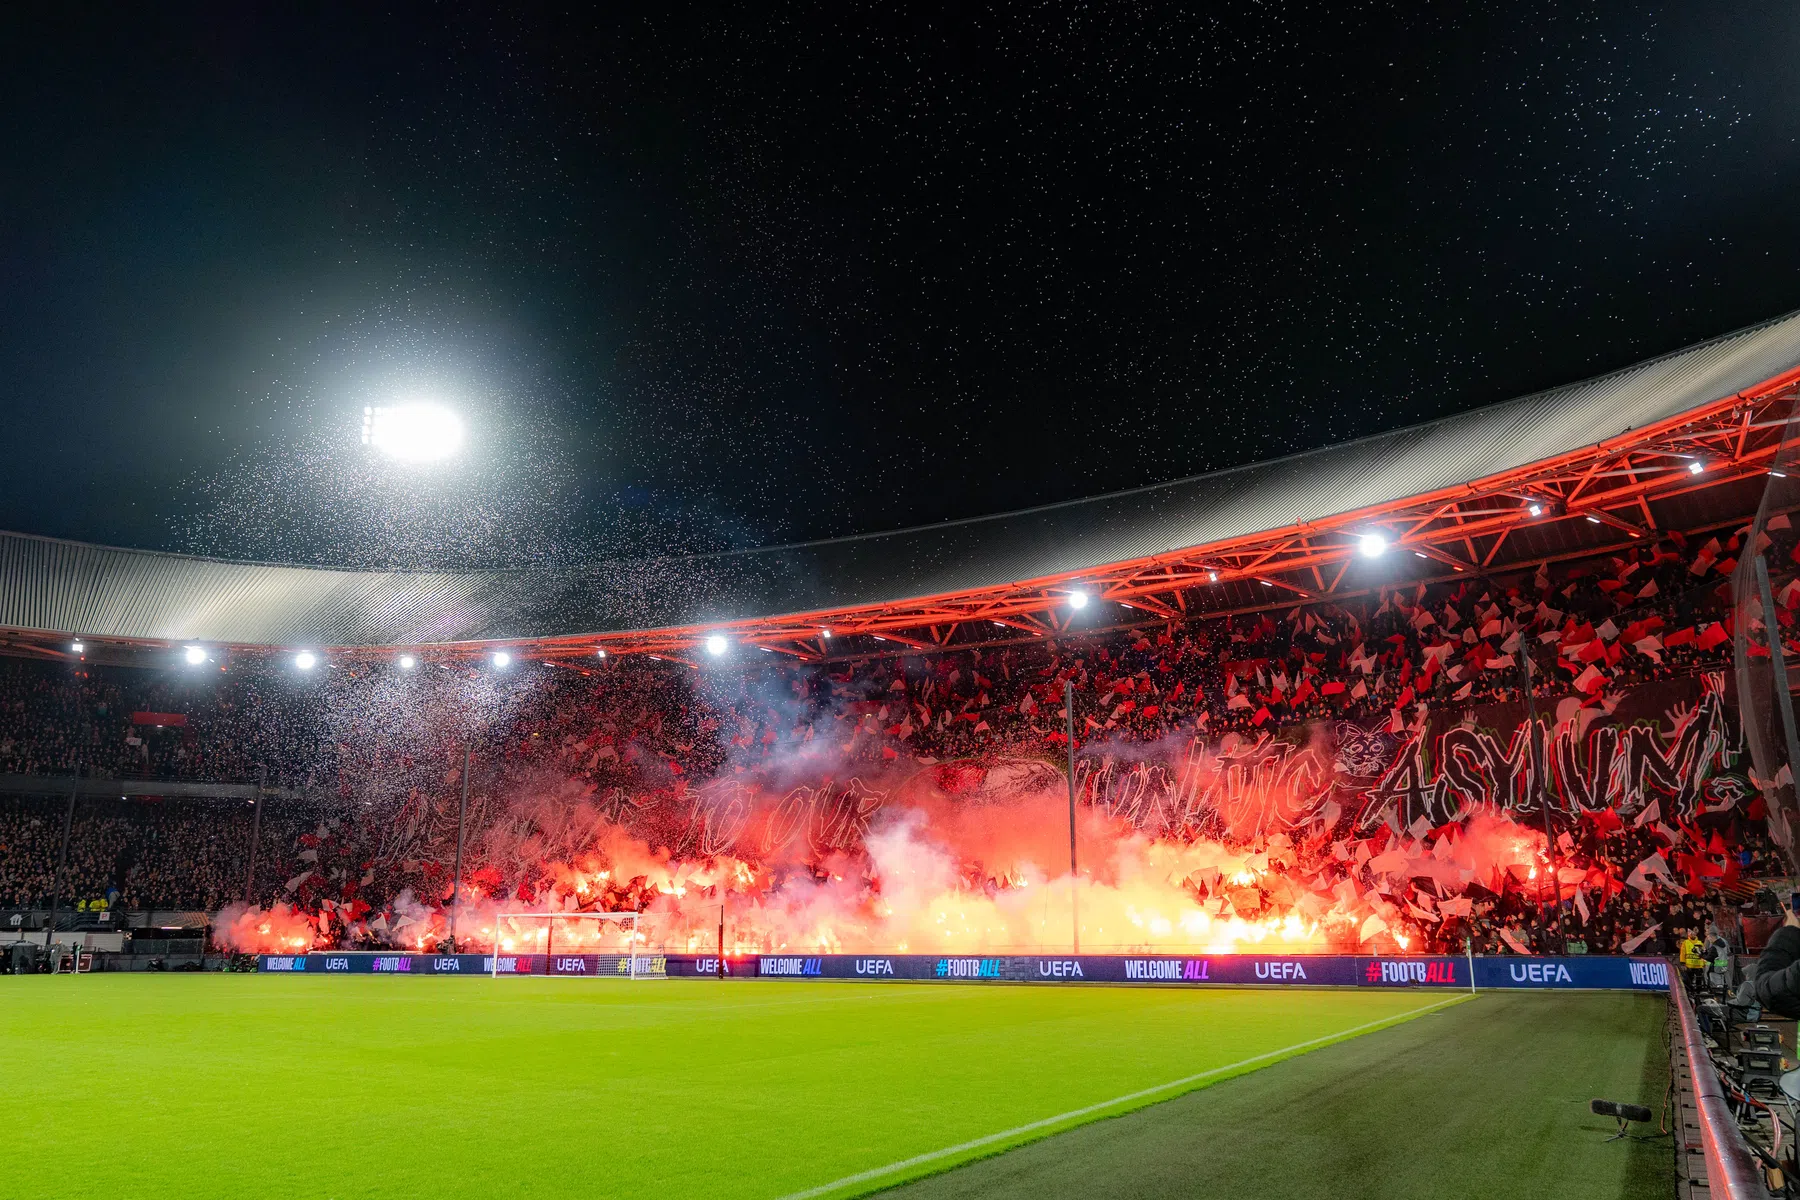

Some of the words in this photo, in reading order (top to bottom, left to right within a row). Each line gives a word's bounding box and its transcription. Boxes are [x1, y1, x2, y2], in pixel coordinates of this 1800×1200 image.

[267, 957, 294, 970] WELCOME
[293, 957, 306, 970] ALL
[326, 958, 348, 970] UEFA
[372, 957, 411, 971] #FOOTBALL
[434, 958, 459, 970] UEFA
[483, 958, 516, 972] WECOME
[516, 958, 532, 972] ALL
[557, 959, 585, 971] UEFA
[617, 958, 667, 973] #FOTBALL
[760, 958, 802, 974] WELCOME
[802, 958, 822, 974] ALL
[856, 960, 893, 974] UEFA
[935, 959, 1001, 976] #FOOTBALL
[1039, 961, 1084, 977] UEFA
[1125, 960, 1182, 979] WELCOME
[1183, 960, 1209, 979] ALL
[1255, 962, 1307, 980] UEFA
[1365, 962, 1456, 982] #FOOTBALL
[1510, 964, 1572, 983] UEFA
